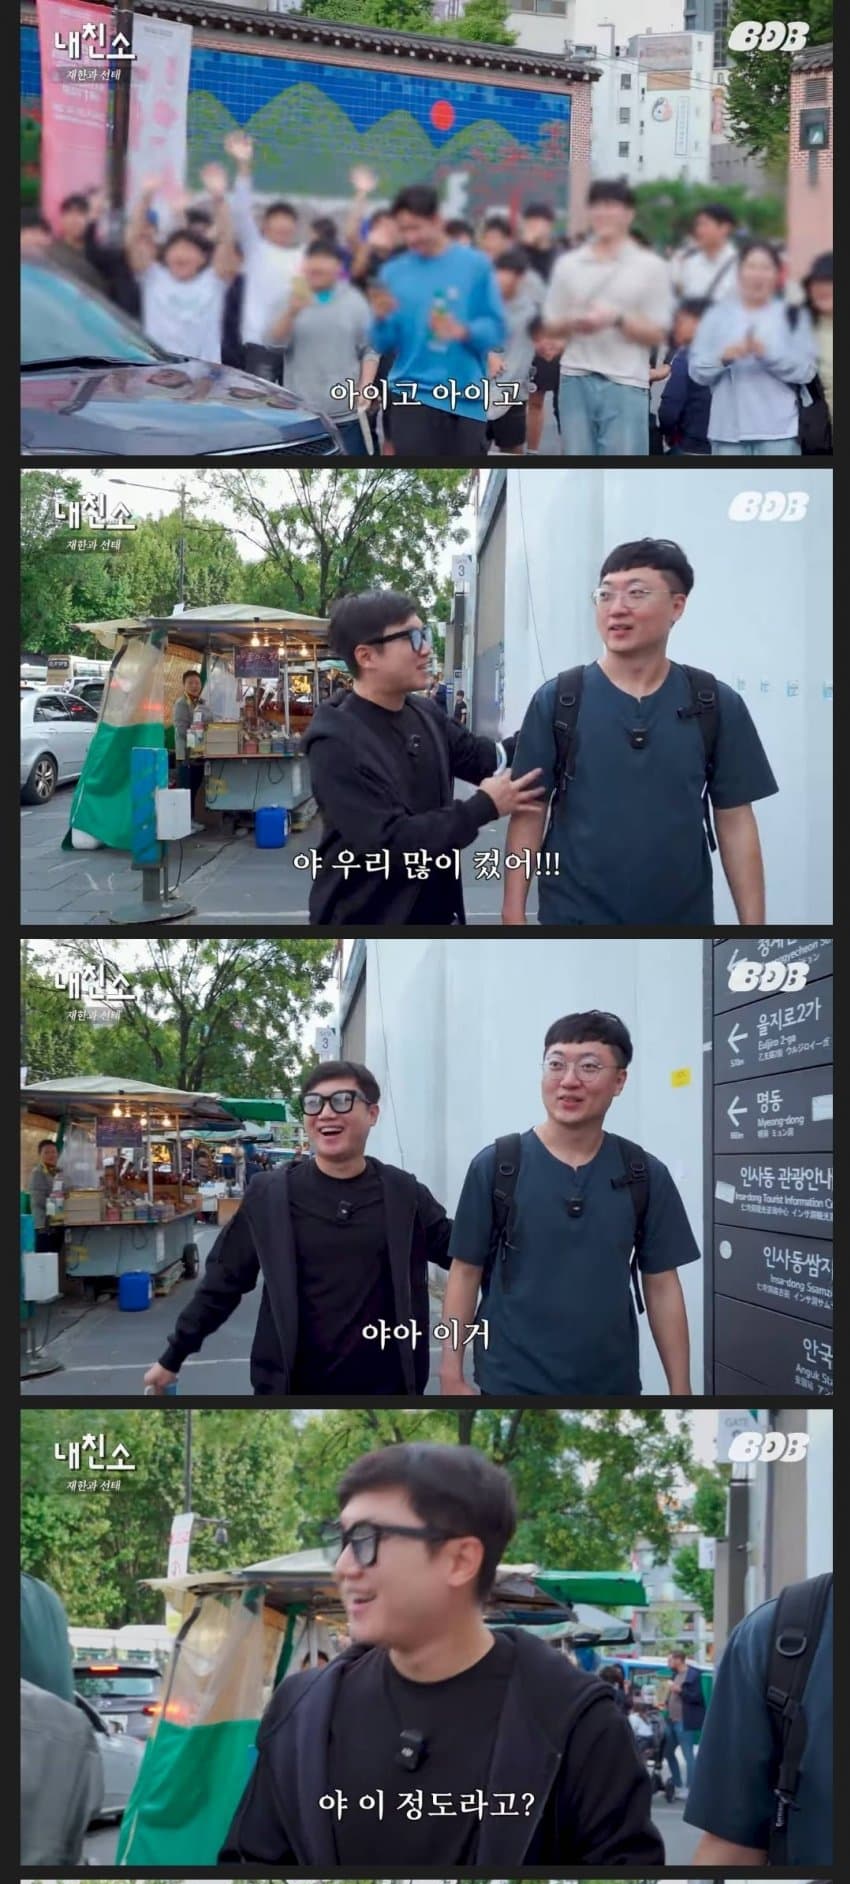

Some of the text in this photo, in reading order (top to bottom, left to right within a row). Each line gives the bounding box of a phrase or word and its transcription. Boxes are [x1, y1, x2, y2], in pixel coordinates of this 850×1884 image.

[756, 997, 822, 1037] 을지로2가
[756, 1089, 783, 1114] 명동
[740, 1165, 776, 1189] 인사동
[784, 1195, 824, 1208] Information
[803, 1337, 833, 1370] 안국
